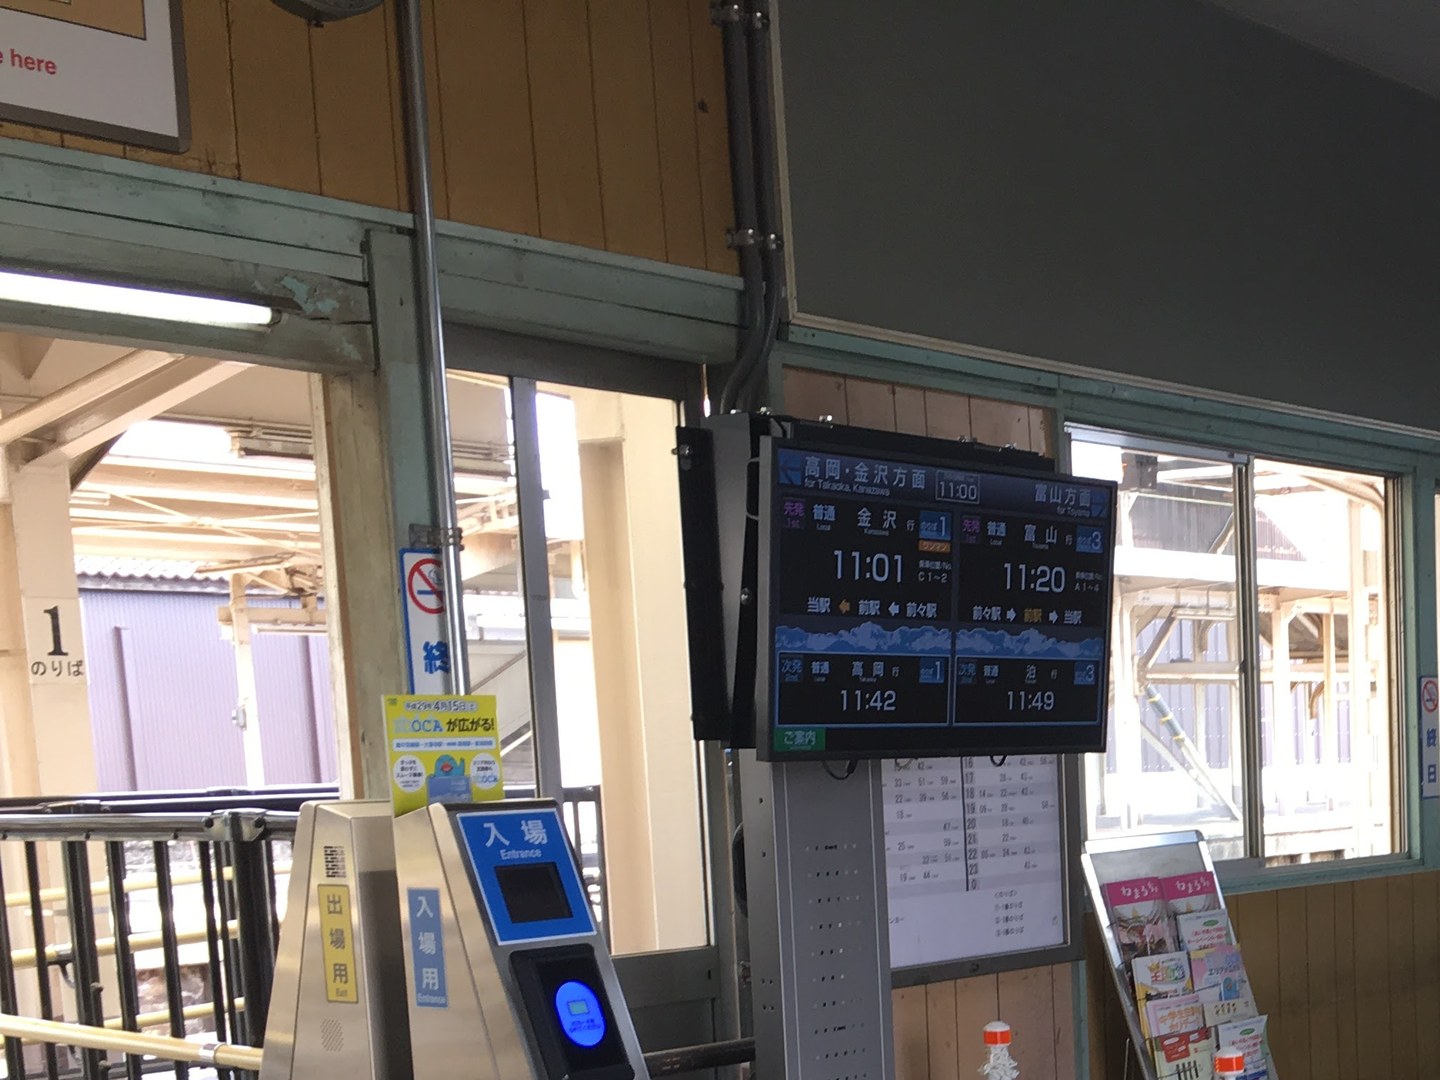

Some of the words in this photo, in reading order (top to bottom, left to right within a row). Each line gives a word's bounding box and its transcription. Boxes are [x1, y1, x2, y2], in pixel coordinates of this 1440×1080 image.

[10, 48, 57, 75] here
[804, 456, 926, 490] 高岡・金沢方面
[804, 478, 816, 489] for
[939, 481, 978, 500] 11:00
[1034, 483, 1092, 508] 富山方面
[783, 501, 806, 518] 先発
[812, 504, 837, 522] 普通
[856, 507, 898, 530] 金沢
[906, 520, 916, 532] 行
[962, 519, 981, 534] 先発
[987, 520, 1007, 537] 普通
[1024, 523, 1058, 545] 富山
[833, 549, 903, 583] 11:01
[1003, 562, 1066, 593] 11:20
[807, 596, 831, 614] 当駅
[858, 599, 881, 616] 前駅
[906, 601, 938, 619] 前々駅
[972, 604, 1002, 622] 前々駅
[1023, 608, 1042, 623] 前駅
[1063, 609, 1083, 625] 当駅
[43, 605, 69, 657] 1
[31, 659, 85, 677] のりば
[811, 660, 830, 676] 普通
[851, 660, 885, 678] 高岡
[983, 665, 999, 677] 普通
[840, 689, 897, 712] 11:42
[1007, 690, 1055, 712] 11:49
[783, 730, 817, 746] ご案内
[1426, 728, 1438, 784] 終日
[482, 819, 548, 848] 入場
[500, 847, 542, 861] Entrance
[968, 848, 977, 860] 22
[326, 893, 349, 985] 出場用
[416, 895, 440, 991] 入場用
[417, 992, 448, 1005] Entrance
